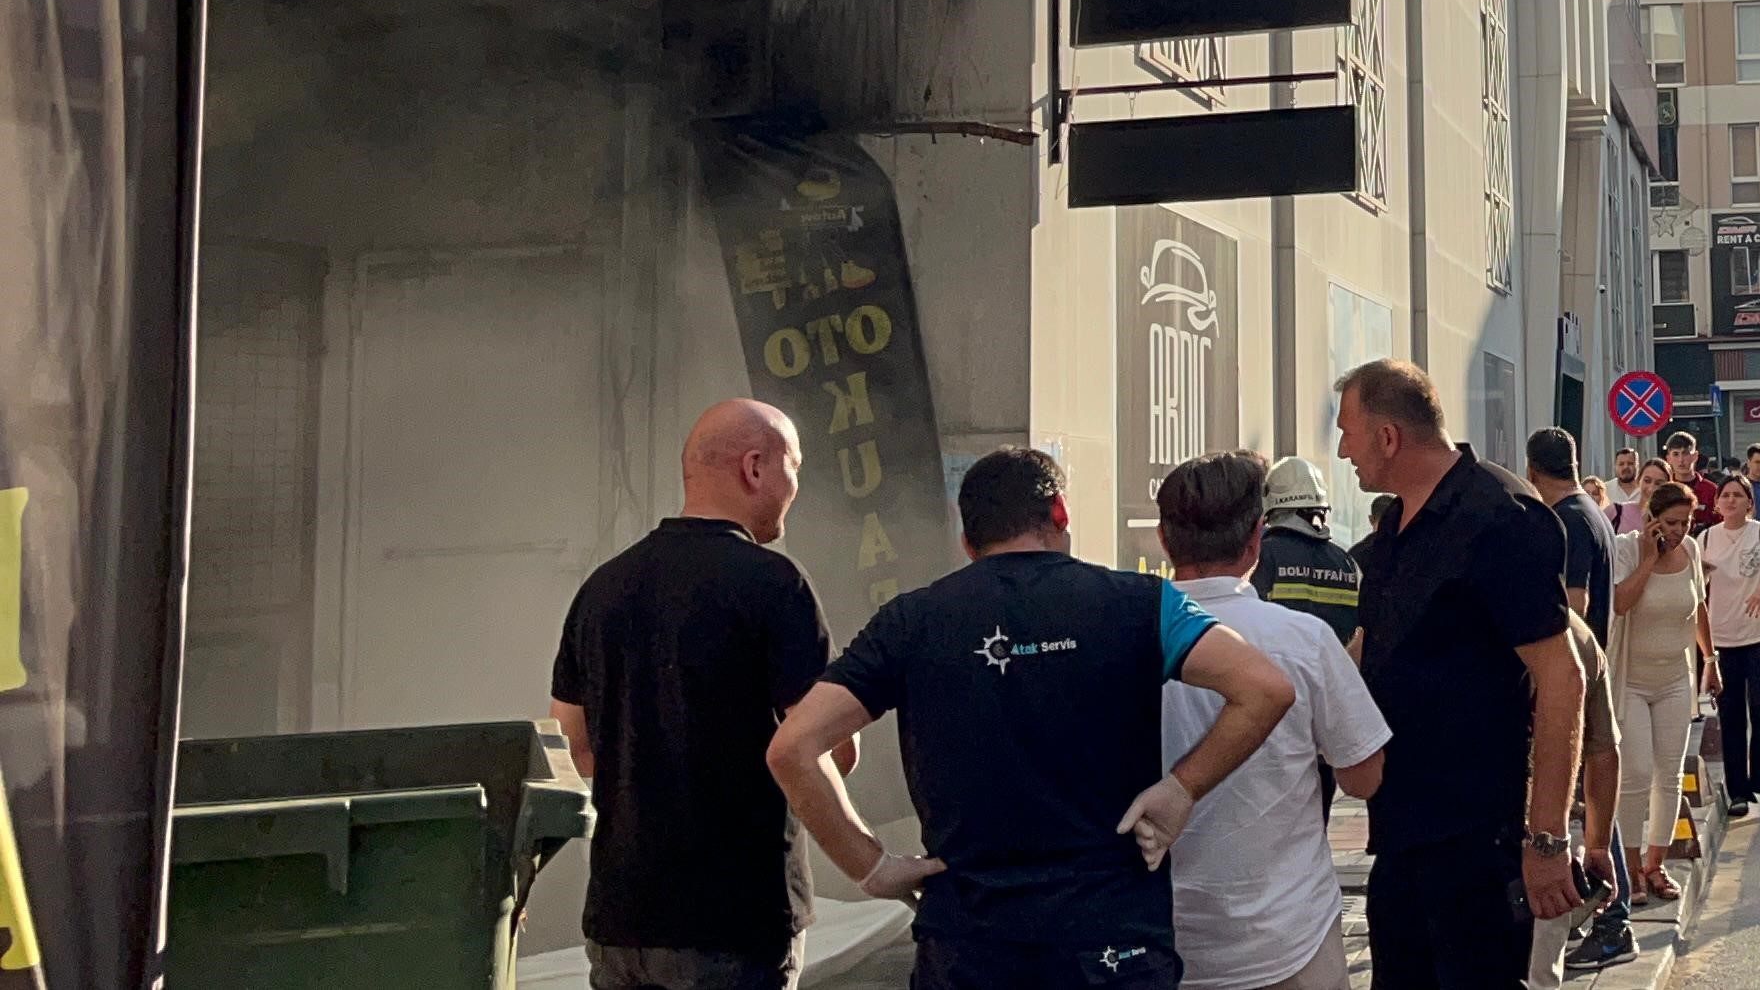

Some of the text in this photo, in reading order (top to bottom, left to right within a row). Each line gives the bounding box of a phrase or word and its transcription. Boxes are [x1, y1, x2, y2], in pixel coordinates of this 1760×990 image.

[1717, 234, 1743, 244] RENT
[1745, 234, 1752, 243] A
[1278, 566, 1310, 577] BOLU
[1011, 637, 1077, 656] Atak Servis
